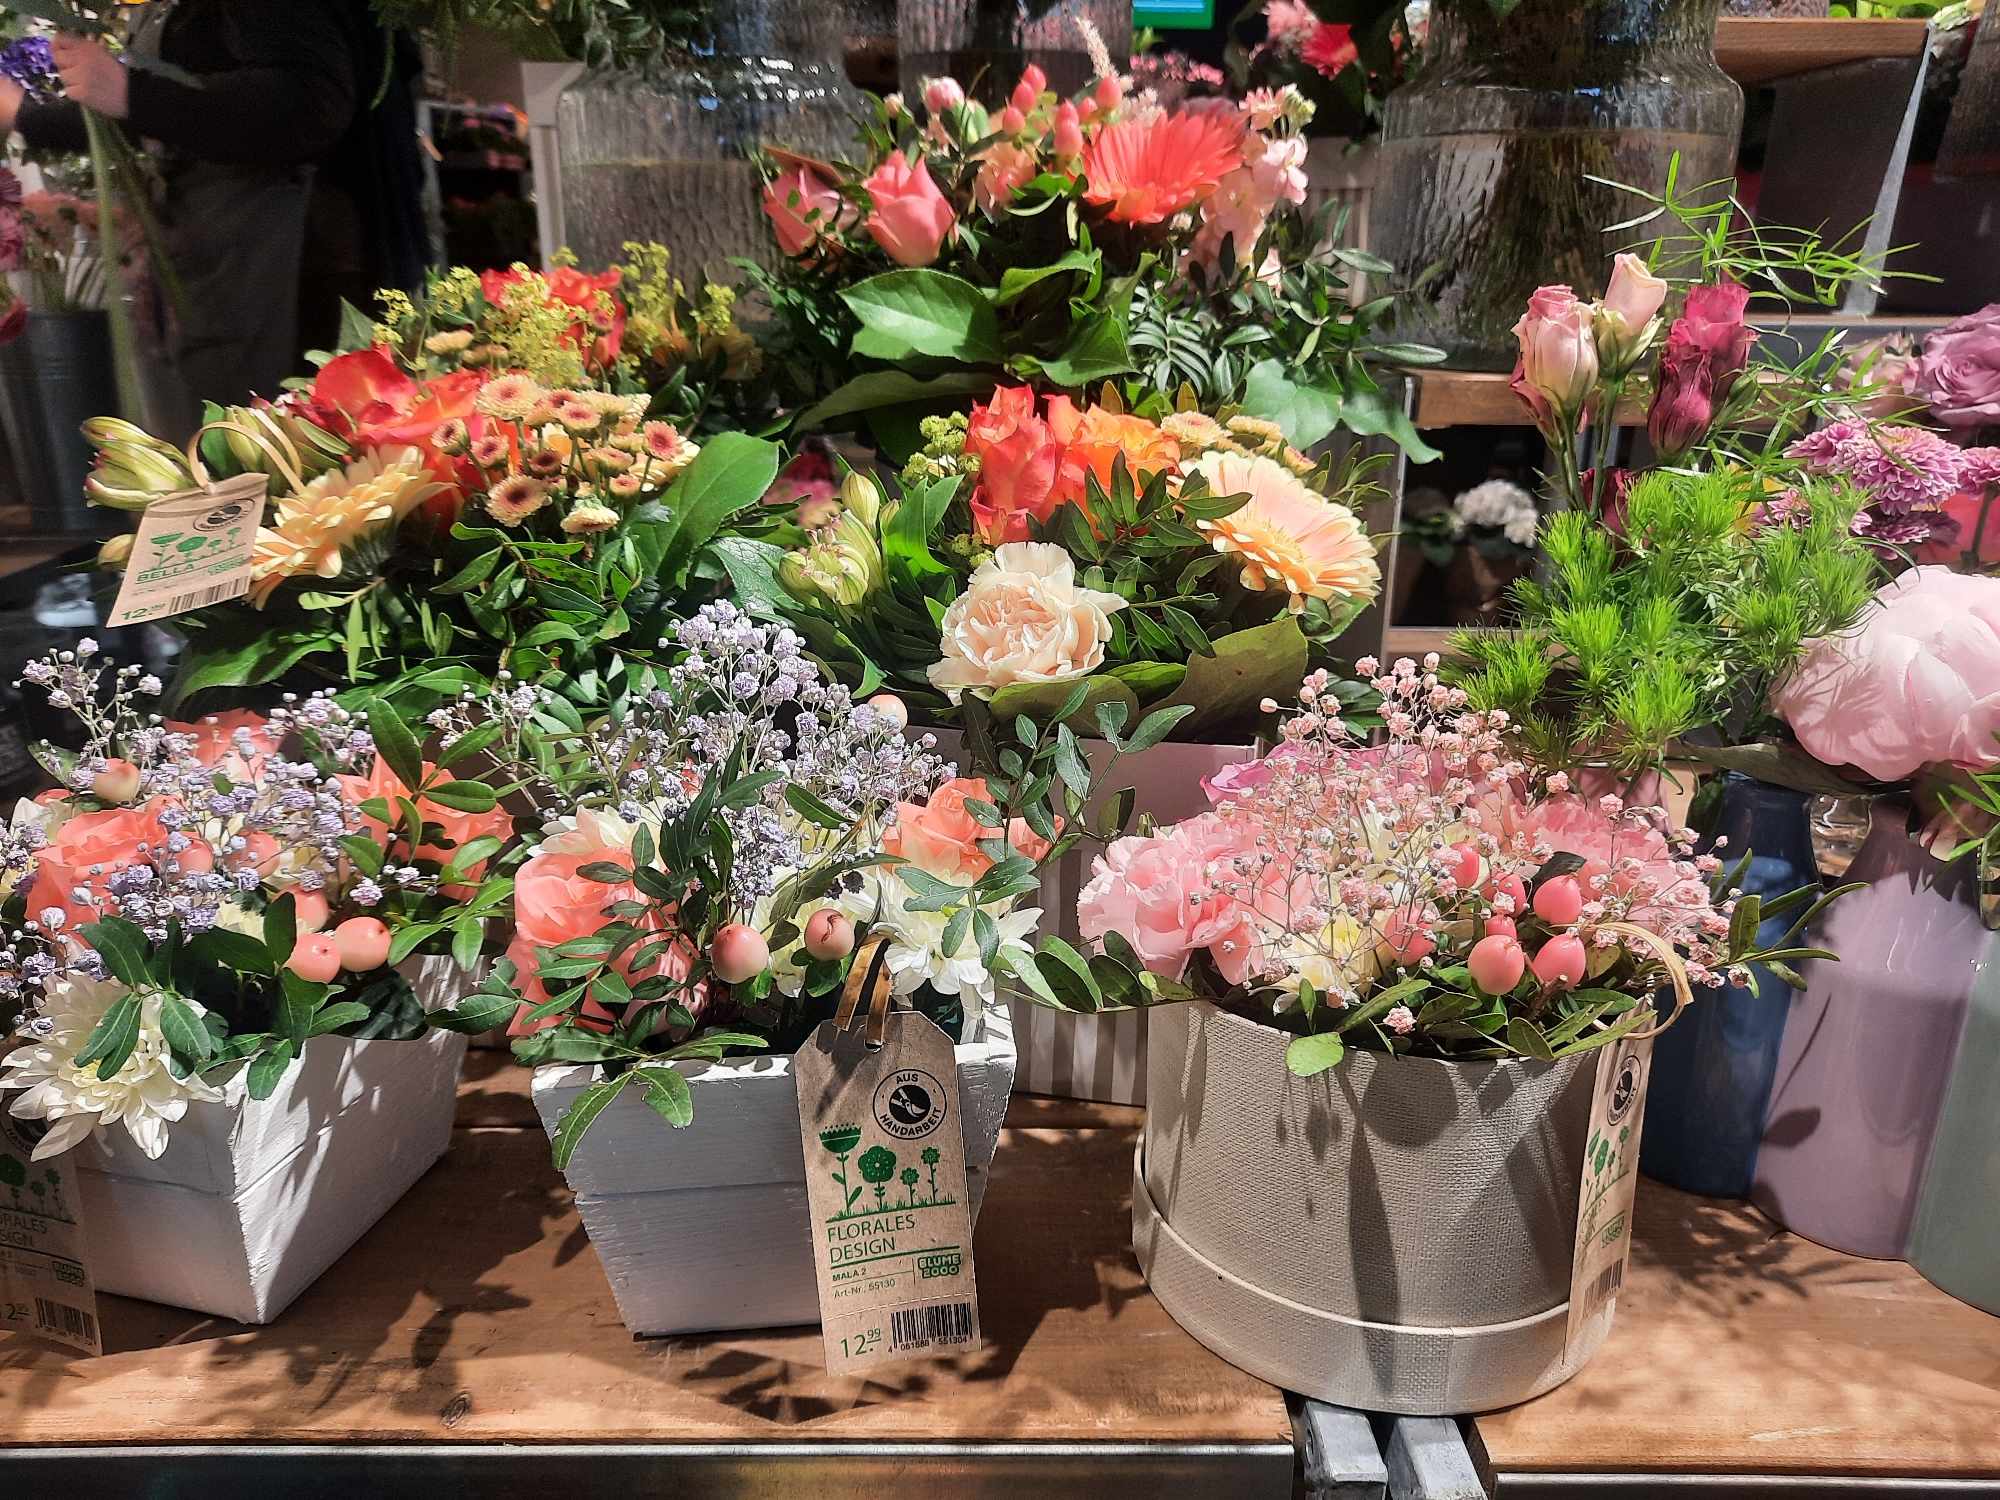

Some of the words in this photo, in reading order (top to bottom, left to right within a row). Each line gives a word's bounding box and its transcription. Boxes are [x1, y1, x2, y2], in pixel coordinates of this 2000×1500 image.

[137, 563, 194, 582] BELLA
[896, 1073, 919, 1084] AUS
[880, 1106, 942, 1136] HANDARBEIT
[827, 1213, 916, 1243] FLORALES
[829, 1236, 896, 1263] DESIGN
[918, 1253, 962, 1269] BLUME
[833, 1270, 859, 1281] MALA
[862, 1268, 867, 1276] 2
[922, 1265, 960, 1278] 2000
[938, 1335, 967, 1345] 551304
